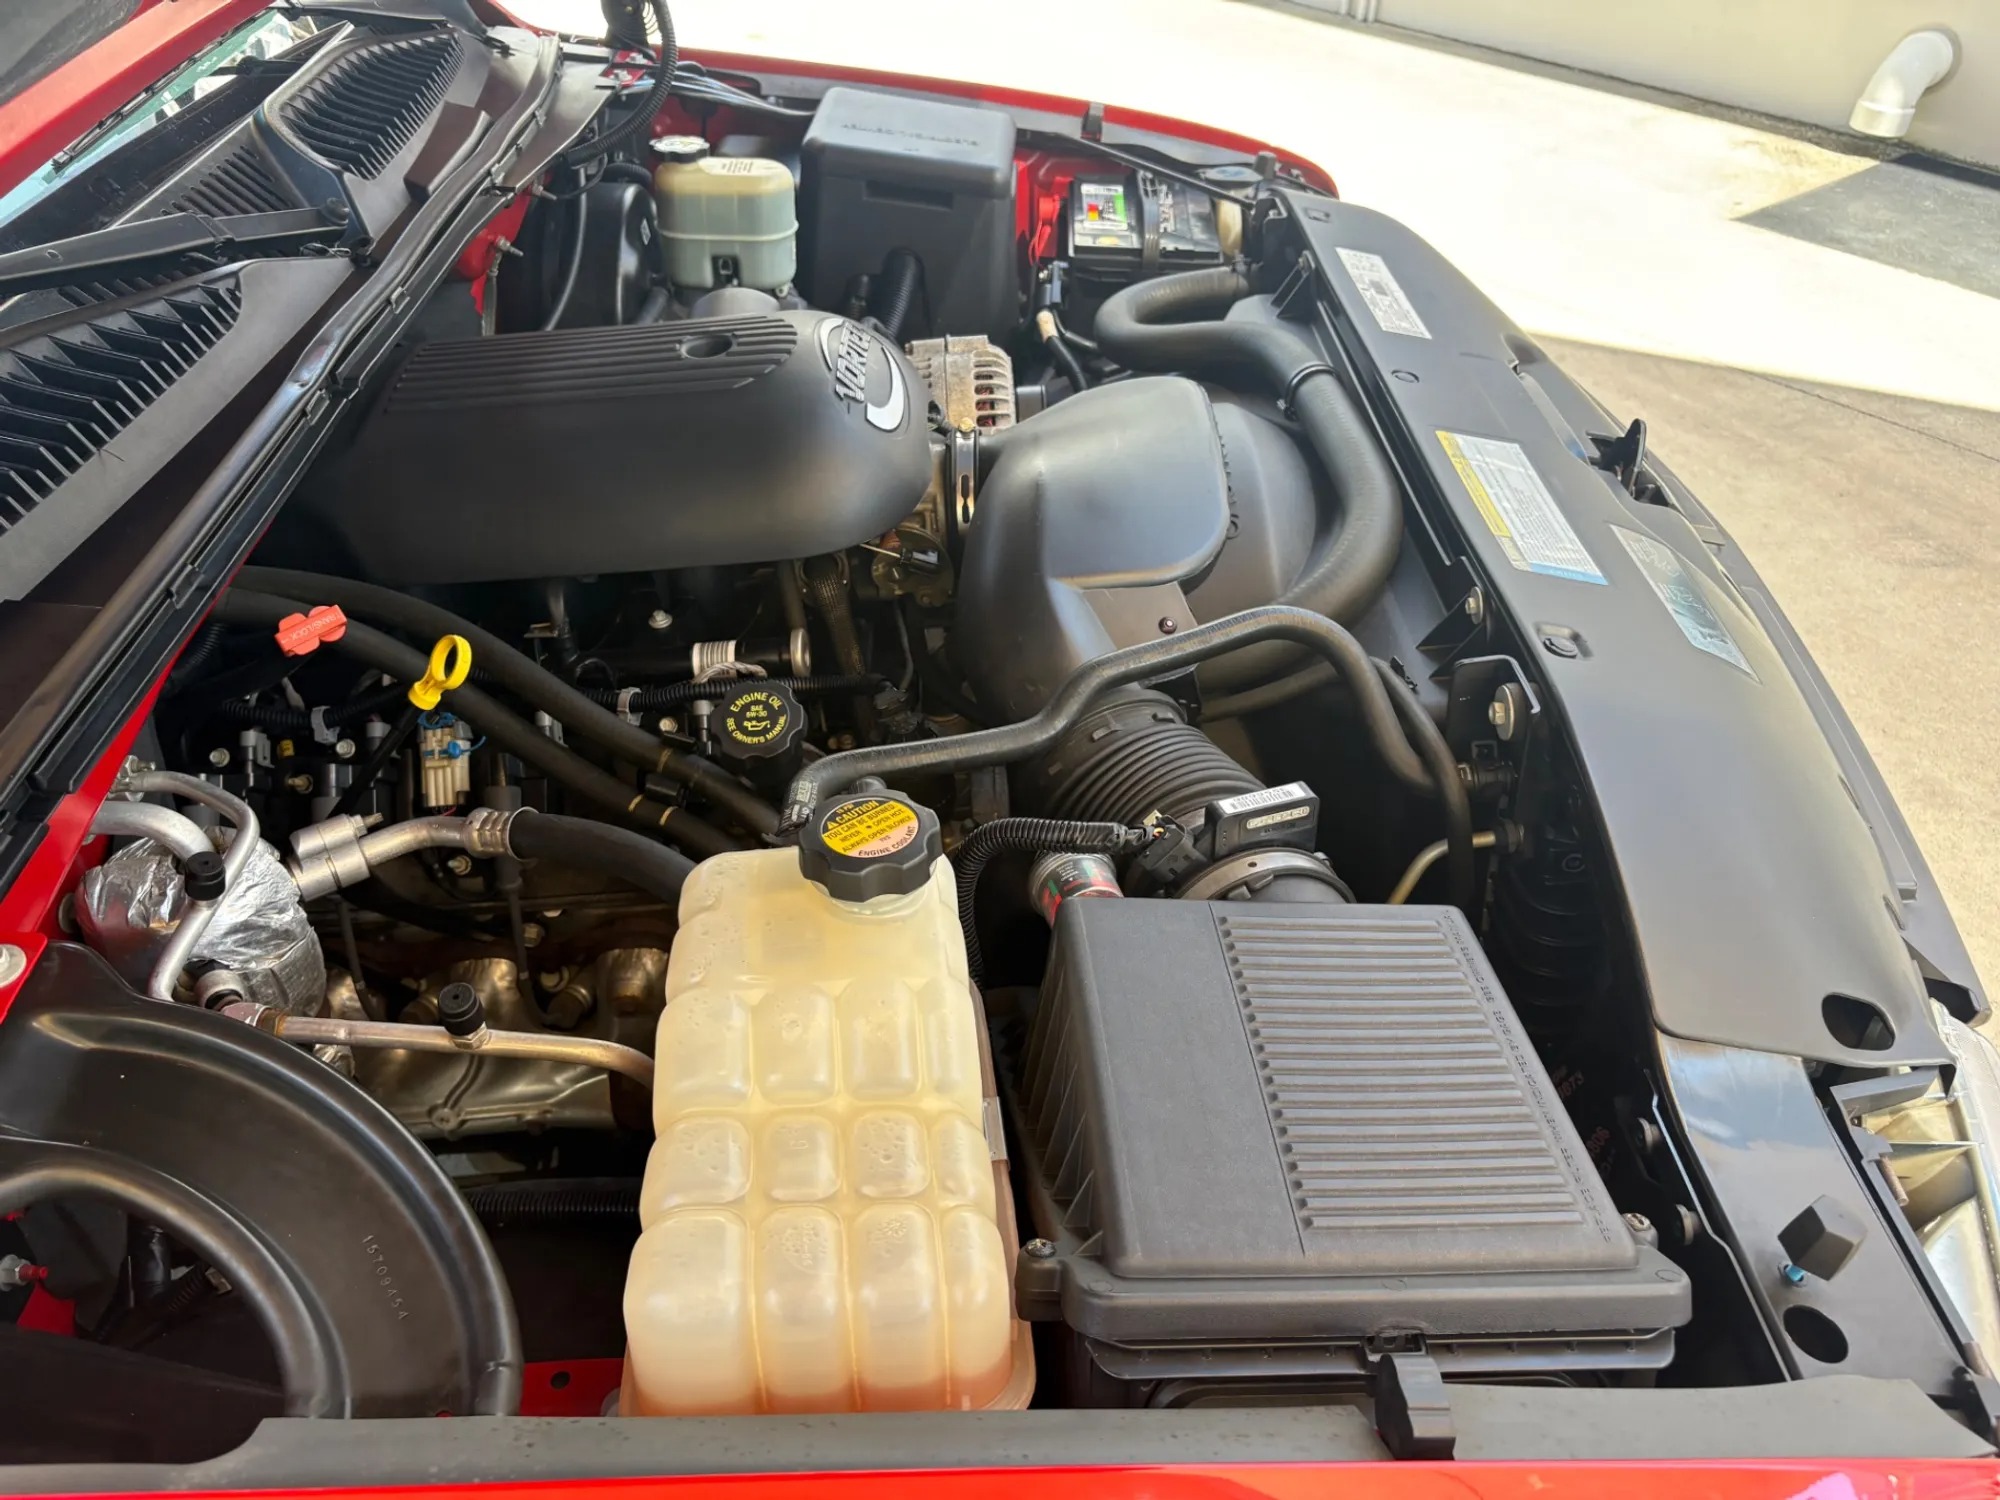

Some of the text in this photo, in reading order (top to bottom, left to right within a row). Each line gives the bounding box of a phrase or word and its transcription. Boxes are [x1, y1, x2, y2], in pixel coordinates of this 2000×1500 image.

[835, 322, 871, 403] VORTEC
[730, 692, 783, 712] ENGINE OIL
[726, 713, 787, 744] SEE OWNER'S MANUAL
[825, 803, 895, 840] YOU CAN BE BURNED
[835, 799, 880, 824] CAUTION
[840, 808, 904, 842] NEVER OPEN HOT
[842, 837, 868, 853] ALWAYS
[868, 827, 887, 840] OPEN
[858, 846, 891, 857] ENGINE
[891, 825, 916, 849] COOLANT
